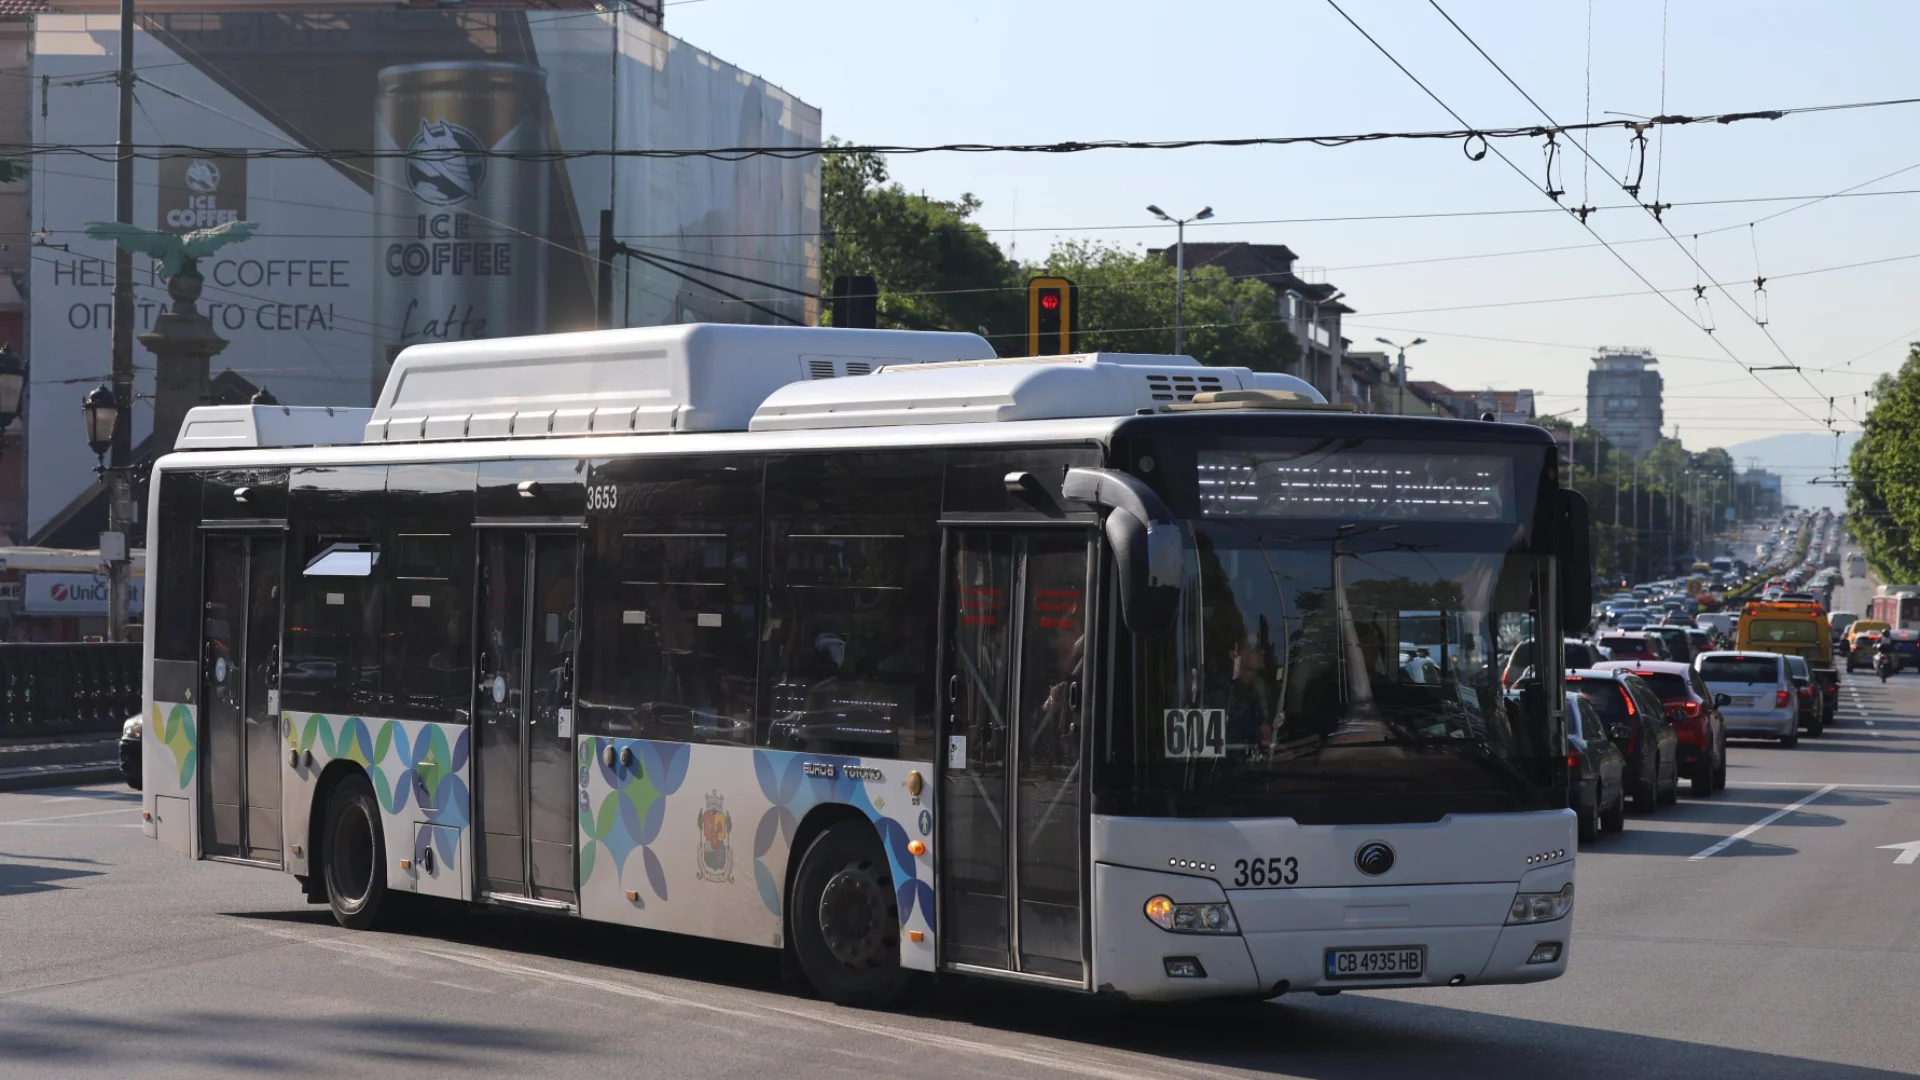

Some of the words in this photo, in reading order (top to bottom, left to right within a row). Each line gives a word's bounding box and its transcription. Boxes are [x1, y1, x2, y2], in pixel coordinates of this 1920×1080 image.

[189, 195, 216, 210] ICE
[167, 209, 237, 227] COFFEE
[418, 214, 470, 240] ICE
[54, 259, 147, 287] HEL
[213, 259, 349, 287] COFFEE
[386, 243, 511, 277] COFFEE
[256, 303, 334, 330] СЕГА!
[401, 298, 488, 341] Latte
[587, 485, 617, 510] 3653
[70, 583, 139, 602] UniCrit
[1166, 710, 1225, 755] 604
[1234, 856, 1299, 887] 3653
[1338, 954, 1358, 972] CB
[1360, 952, 1396, 972] 4935
[1399, 952, 1419, 970] HB
